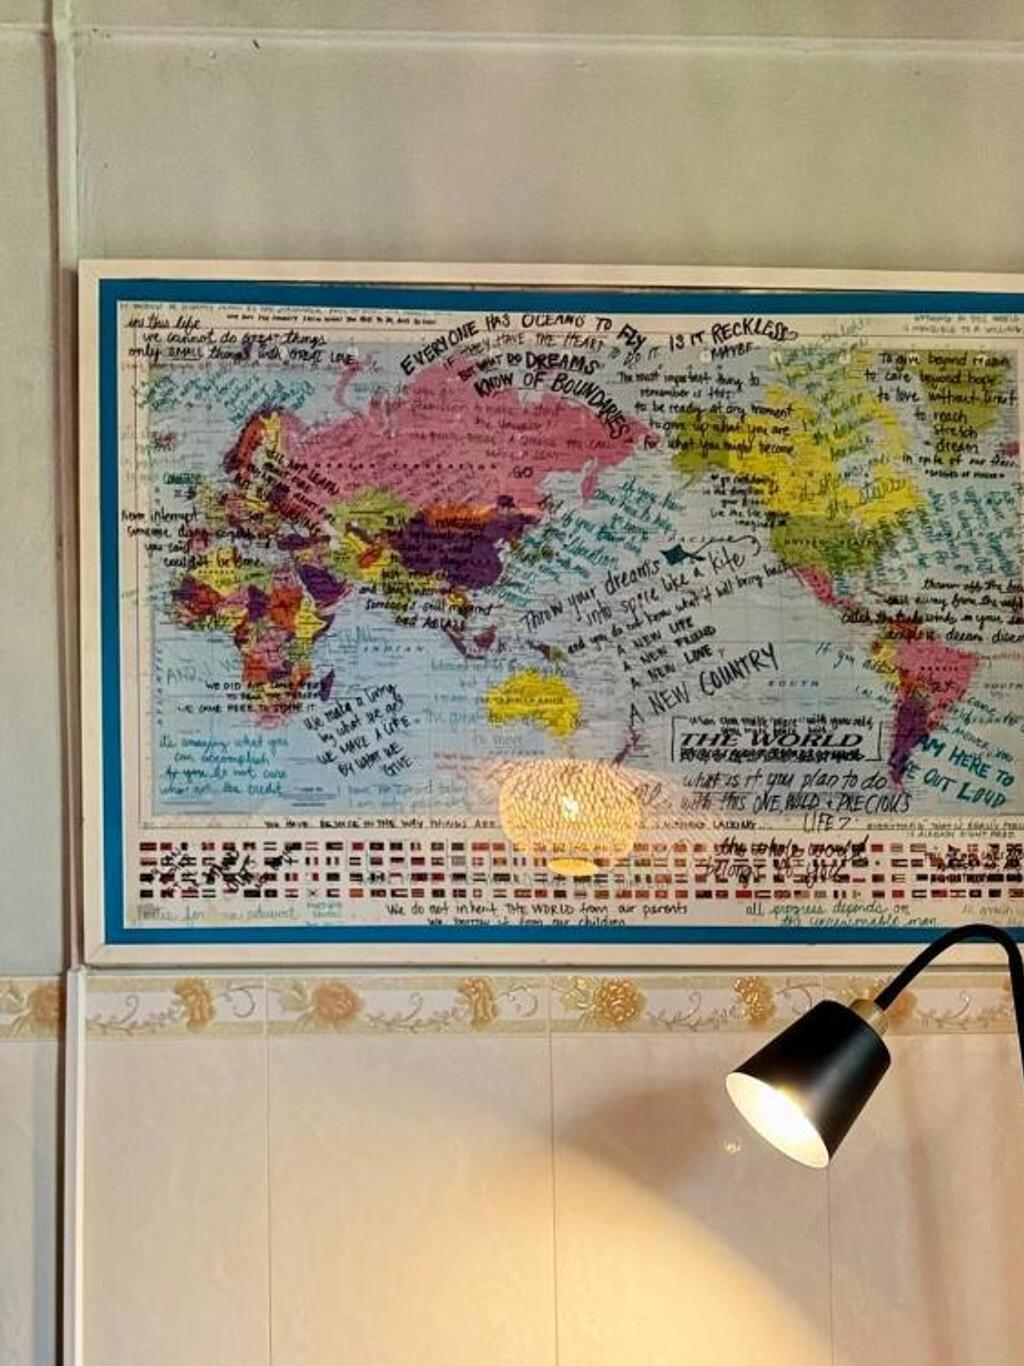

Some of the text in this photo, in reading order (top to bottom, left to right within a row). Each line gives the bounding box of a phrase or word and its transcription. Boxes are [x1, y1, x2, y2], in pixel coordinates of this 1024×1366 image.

[220, 330, 327, 348] do things
[400, 320, 480, 376] EVERYONE
[485, 314, 511, 331] HAS
[596, 317, 612, 331] TO
[617, 324, 647, 351] FLY
[670, 318, 789, 351] IS IT RECKLESS
[525, 351, 602, 375] DREAMS
[750, 371, 760, 386] to
[473, 372, 630, 440] KNOW OF BOUNDARIES
[894, 386, 920, 402] love
[653, 402, 795, 420] be moment
[522, 559, 661, 634] Throw your dreams
[586, 603, 613, 627] into
[662, 573, 689, 592] like
[709, 546, 745, 572] kite
[632, 630, 662, 651] NEW
[669, 617, 695, 635] LIFE
[640, 648, 668, 665] NEW
[647, 662, 677, 681] NEW
[683, 644, 714, 665] LOVE
[627, 642, 782, 728] A NEW COUNTRY
[681, 733, 864, 748] THE WORLD
[948, 745, 1015, 787] HERE TO
[683, 769, 888, 794] what you plan to do
[924, 768, 1007, 808] OUT LOUD
[719, 791, 746, 811] this
[835, 794, 913, 815] PRECIOUS
[386, 904, 408, 916] We
[410, 904, 425, 916] do
[455, 903, 498, 915] inherit
[506, 904, 528, 915] THE
[531, 904, 575, 916] WORLD
[581, 903, 609, 915] from
[642, 903, 688, 919] parents
[746, 902, 764, 916] all
